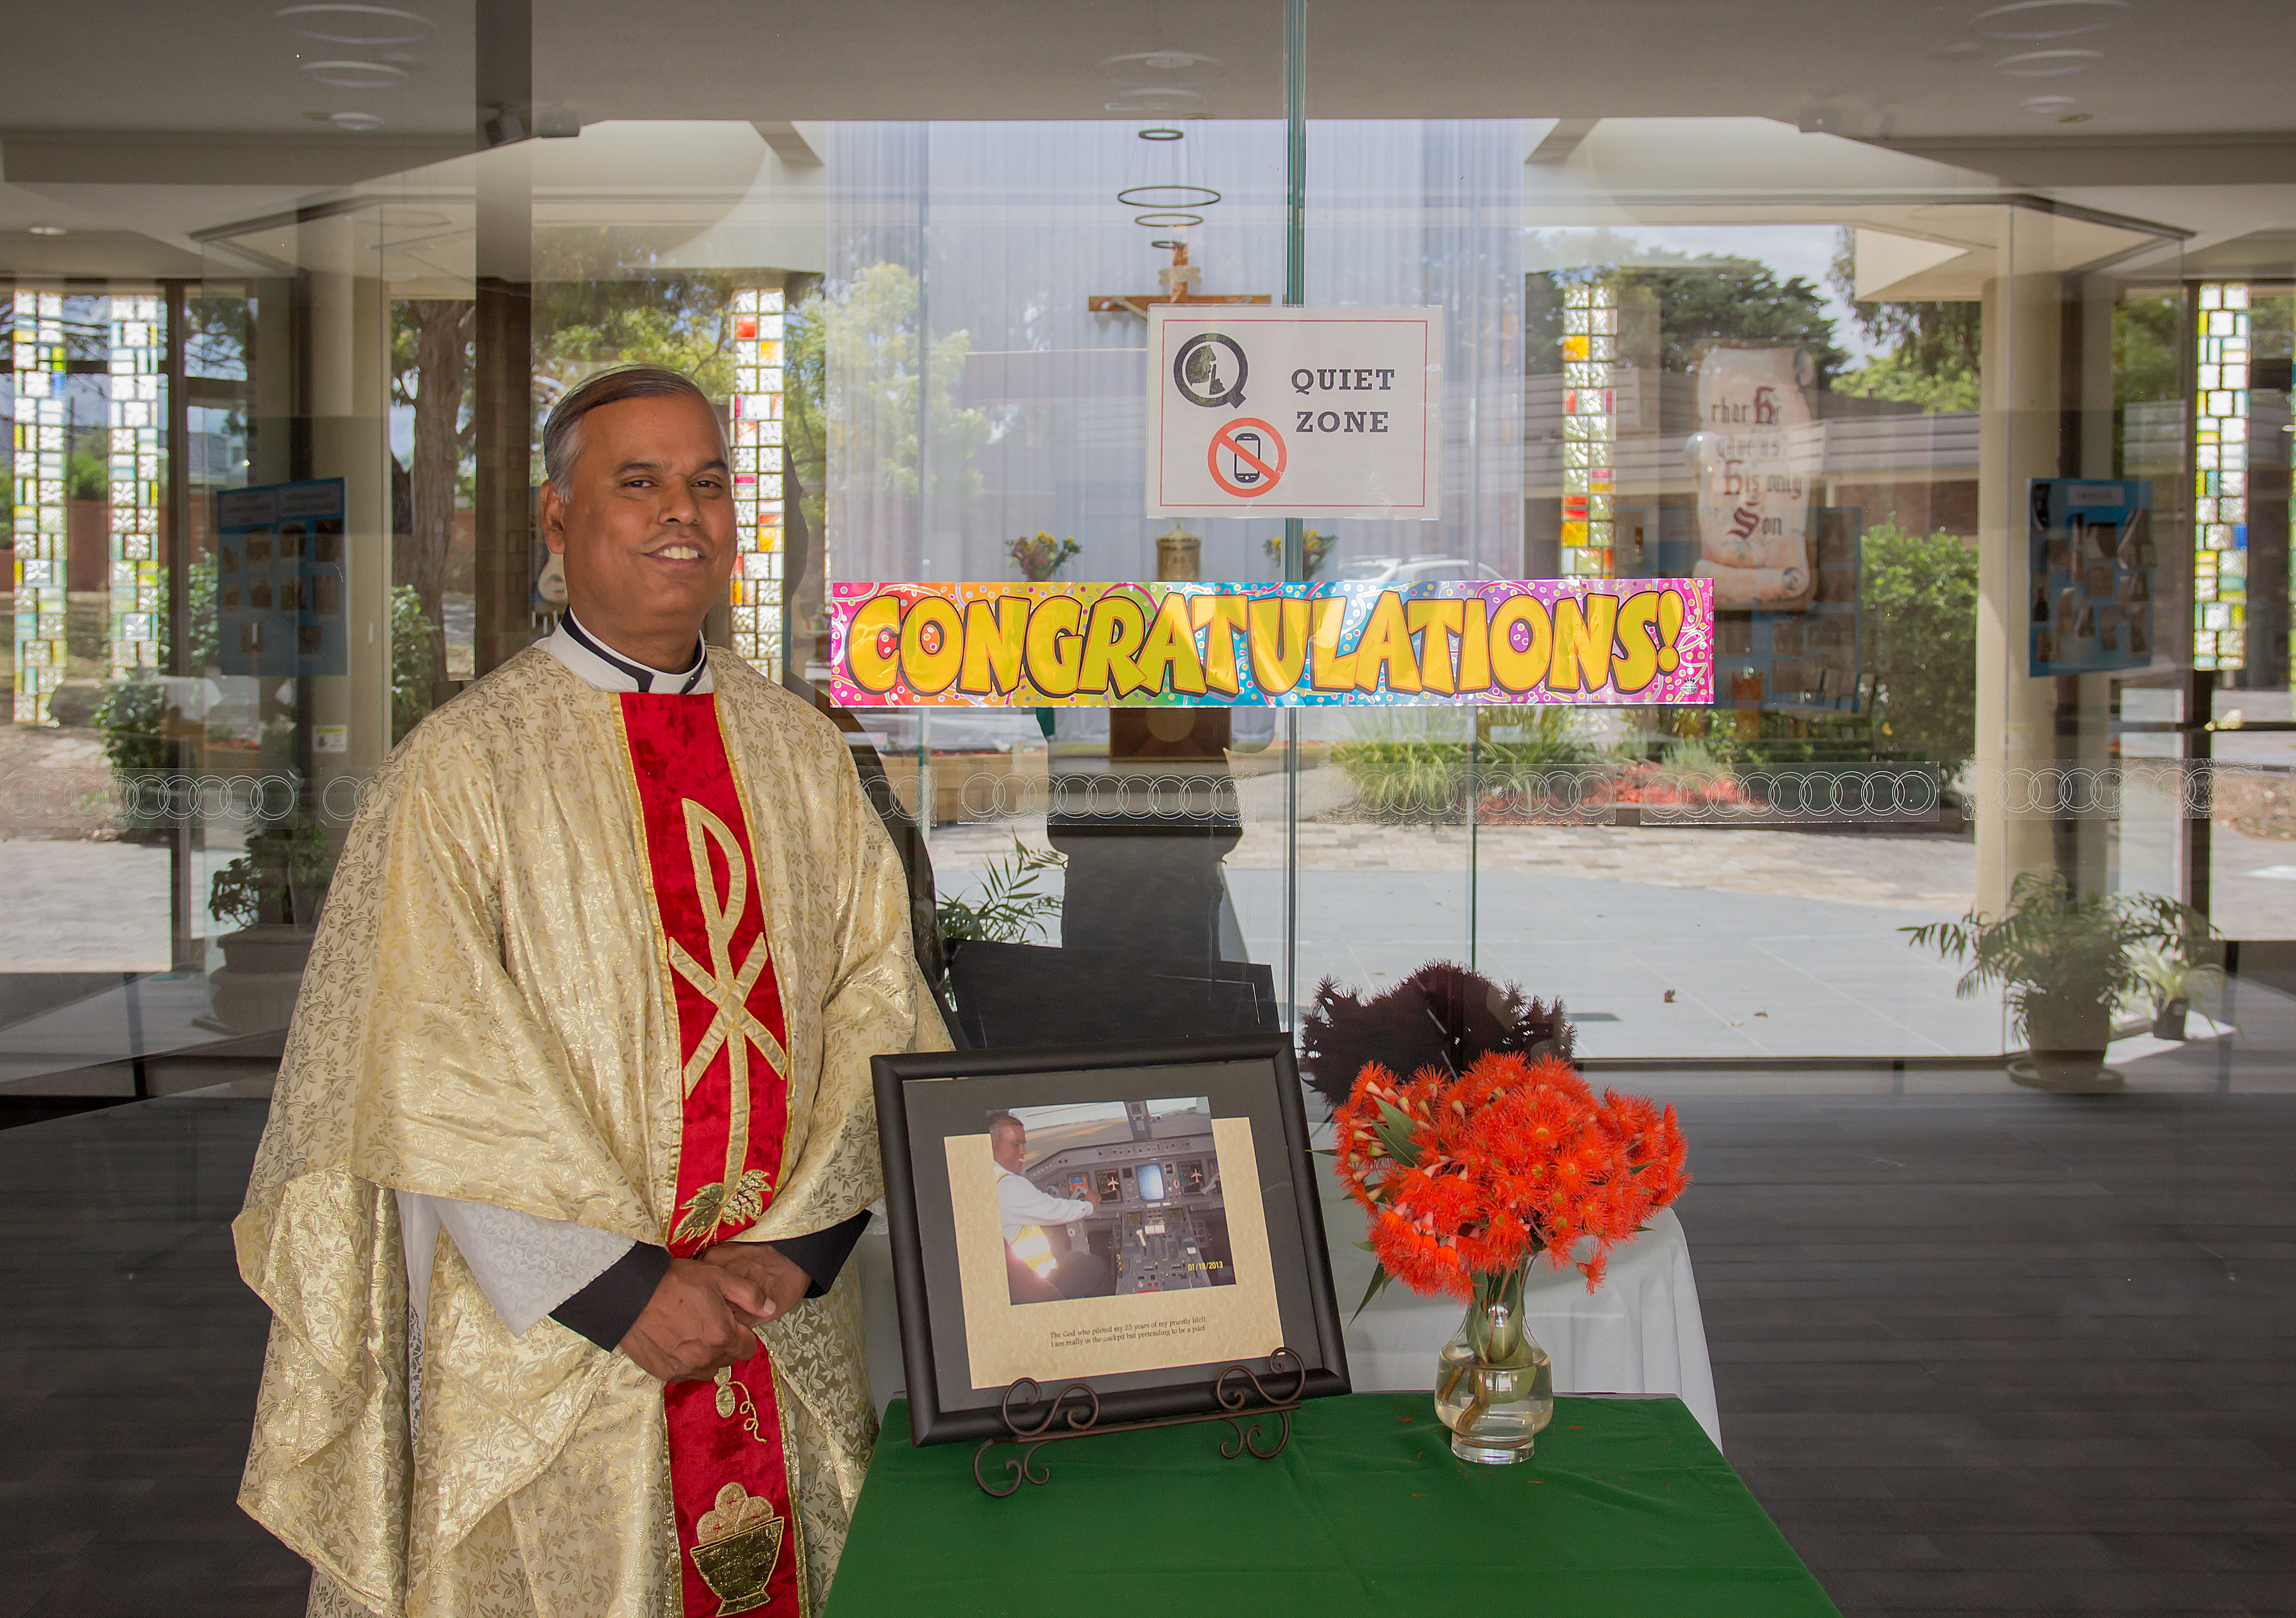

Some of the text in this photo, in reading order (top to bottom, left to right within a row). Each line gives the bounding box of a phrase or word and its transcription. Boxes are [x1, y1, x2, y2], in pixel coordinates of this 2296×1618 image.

[1291, 368, 1395, 395] QUIET
[1296, 411, 1389, 433] ZONE
[1724, 459, 1802, 499] His only
[1727, 507, 1783, 539] Son
[846, 589, 1685, 699] CONGRATULATIONS!
[1092, 1326, 1113, 1336] piloted
[1169, 1318, 1191, 1327] priestly
[1138, 1329, 1170, 1339] pretending
